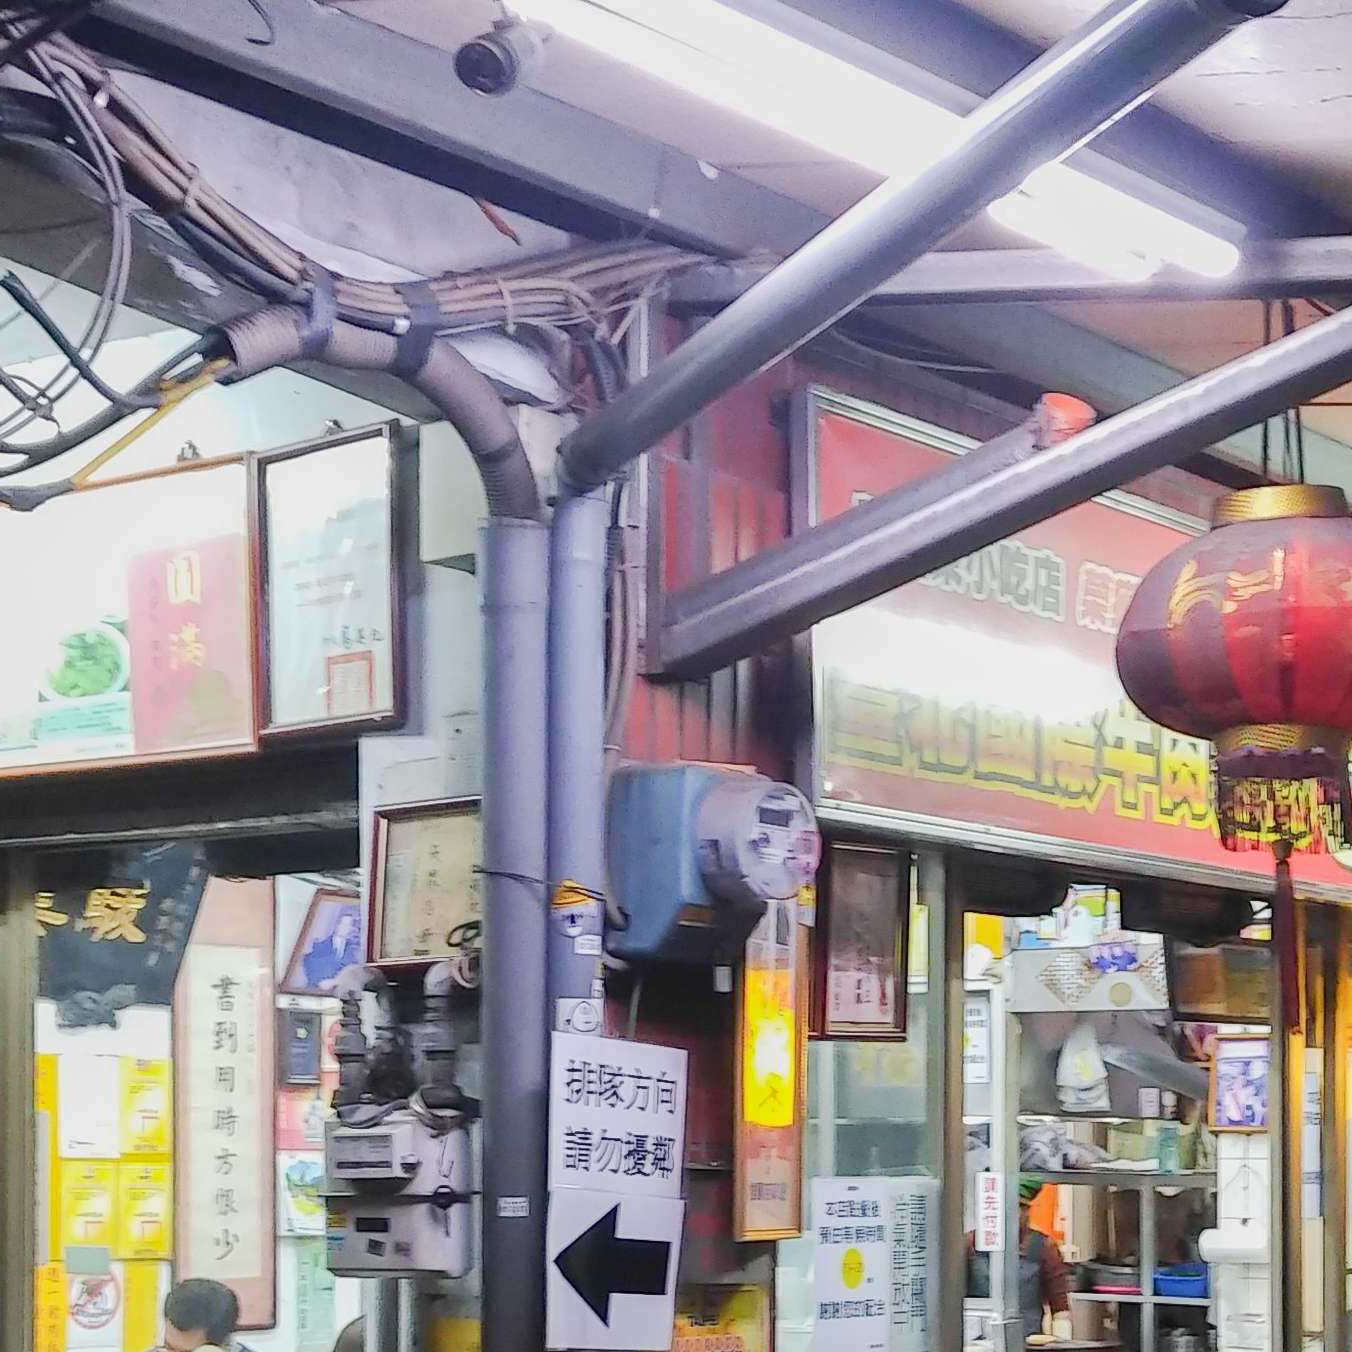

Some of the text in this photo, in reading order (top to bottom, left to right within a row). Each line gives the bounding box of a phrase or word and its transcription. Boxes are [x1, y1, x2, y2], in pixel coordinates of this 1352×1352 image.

[564, 1058, 679, 1116] 排隊方向
[211, 975, 240, 1261] 書到用時方恨少
[564, 1126, 676, 1180] 請勿擾鄰
